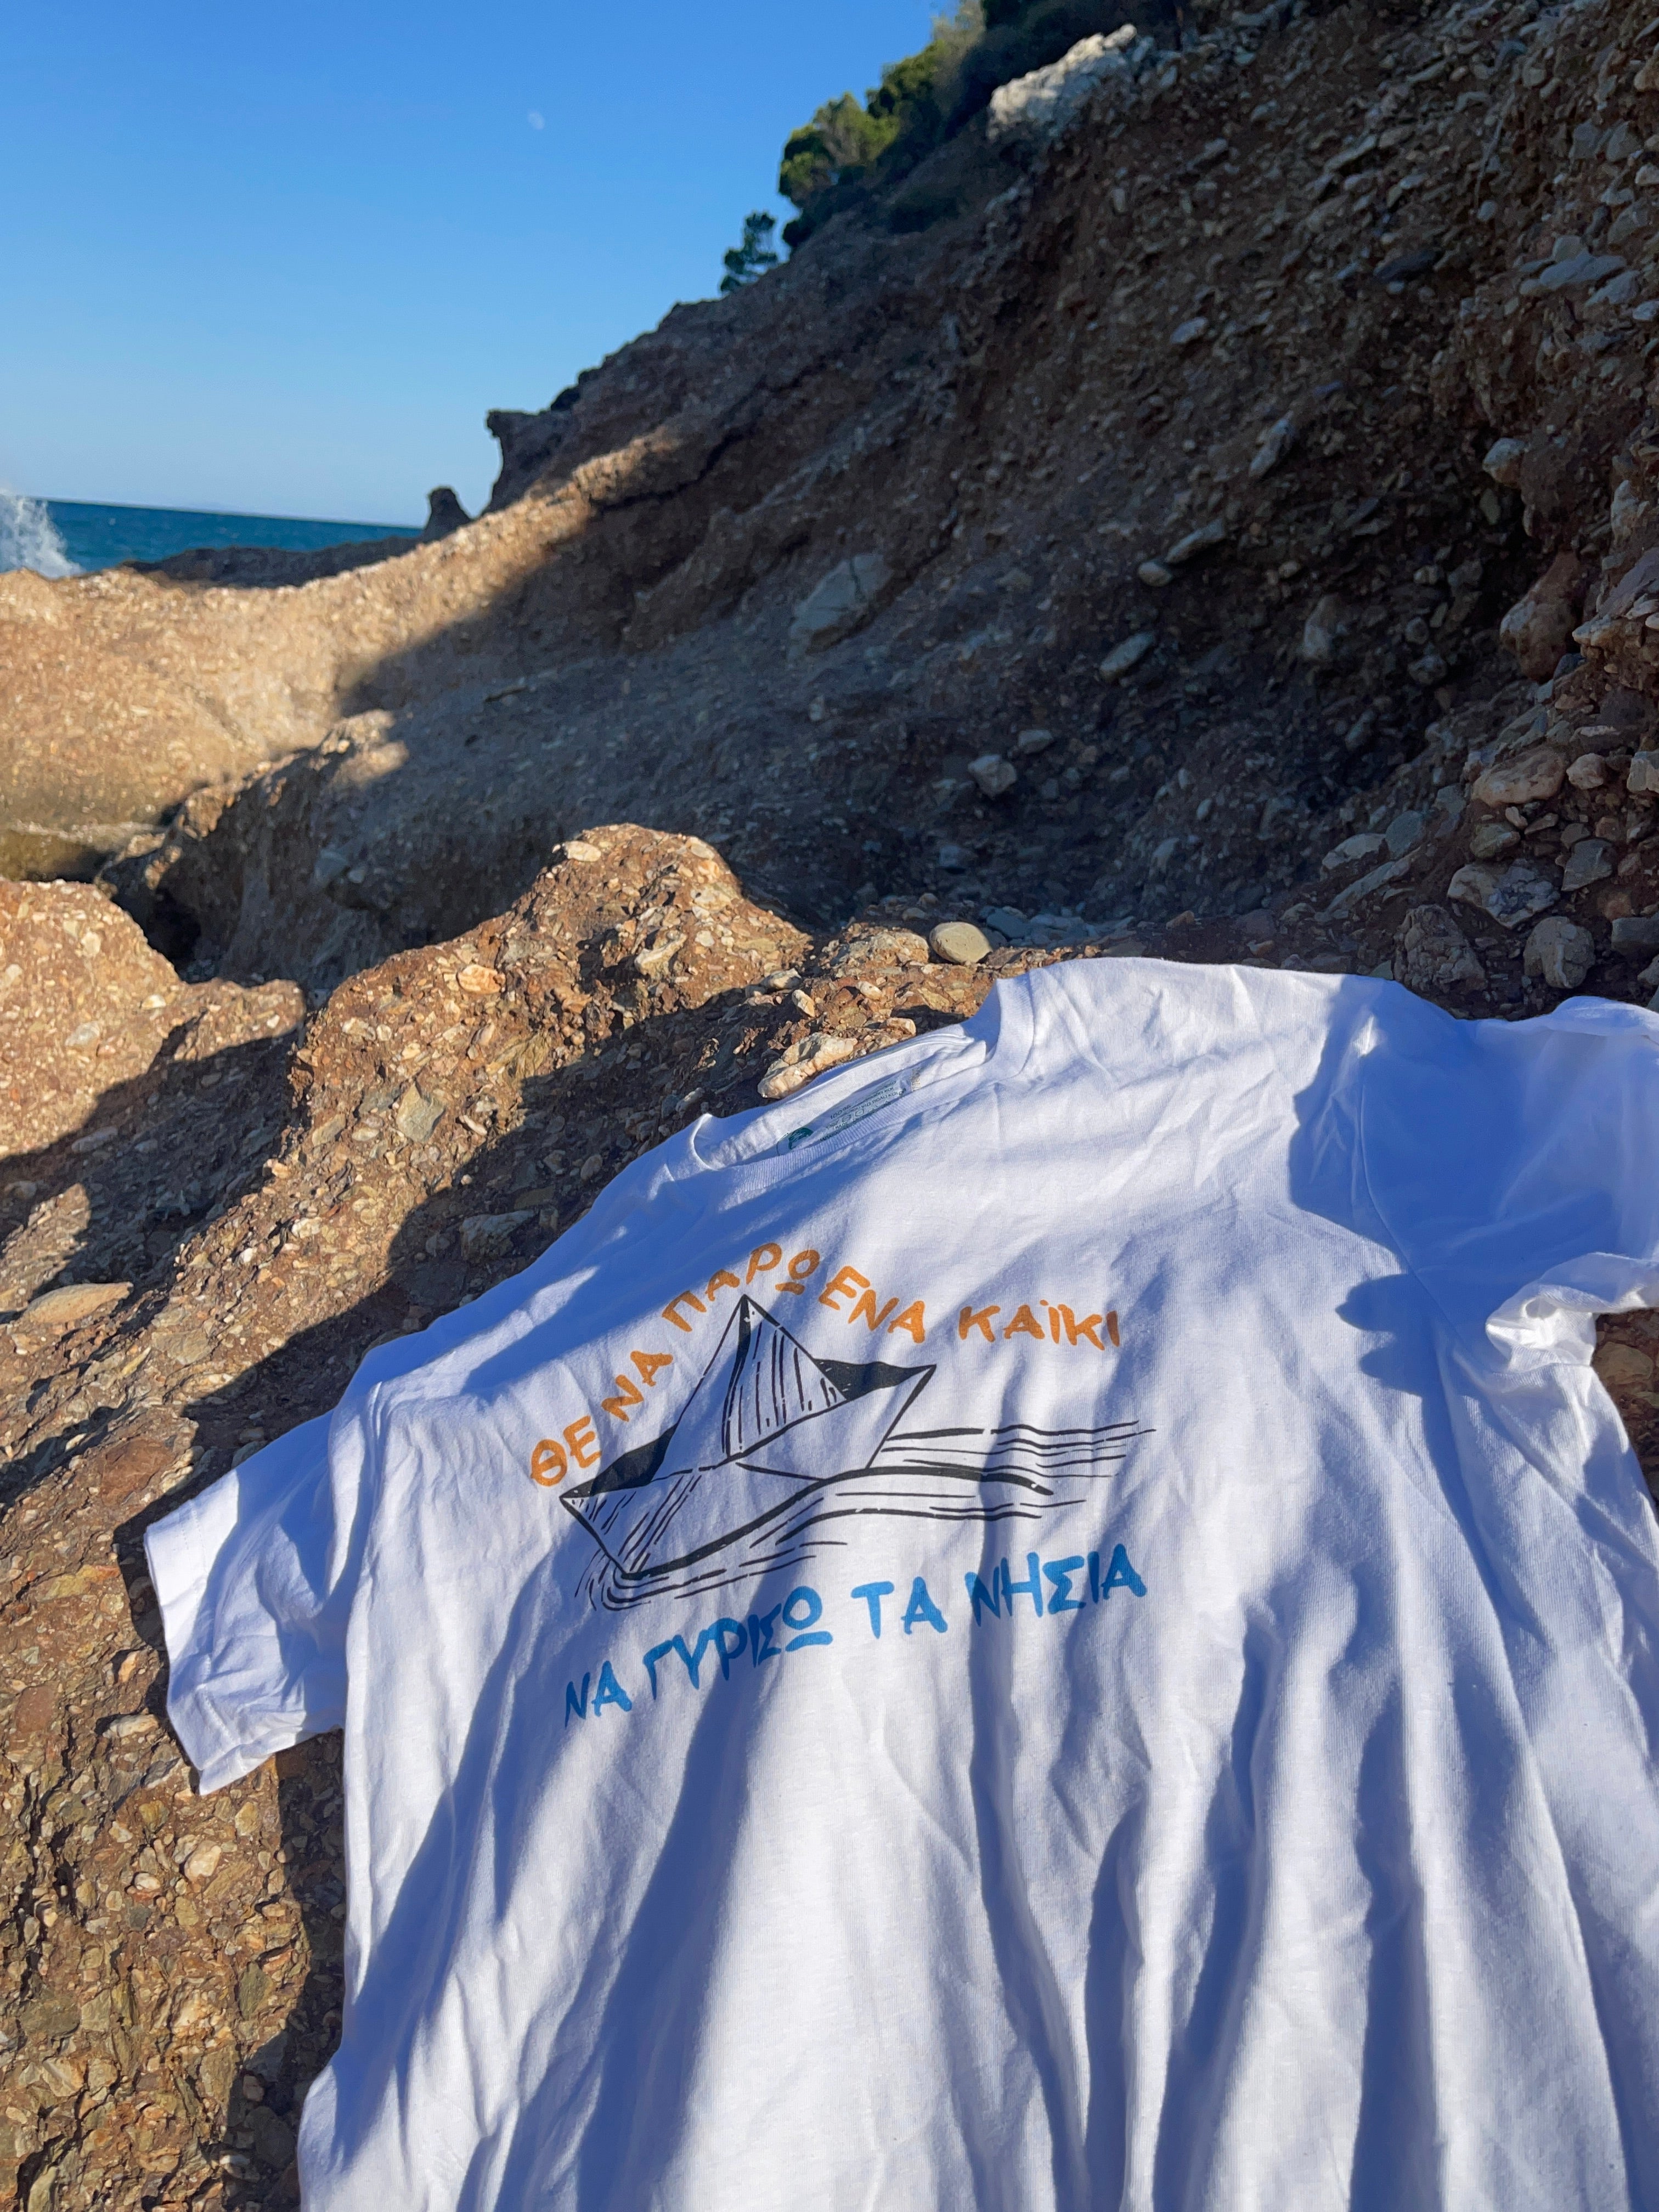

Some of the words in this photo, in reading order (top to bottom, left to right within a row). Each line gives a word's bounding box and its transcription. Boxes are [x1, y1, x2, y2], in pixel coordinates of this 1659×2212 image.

[531, 1415, 602, 1487] ΘΕ
[601, 1349, 674, 1422] ΝΑ
[661, 1243, 820, 1333] ΠΑΡΩ
[819, 1265, 927, 1344] ΕΝΑ
[565, 1660, 633, 1728] ΝΑ
[643, 1585, 833, 1701] ΓΥΡΙΣΩ
[850, 1576, 949, 1639] ΤΑ
[964, 1543, 1148, 1627] ΝΗΣΙΑ
